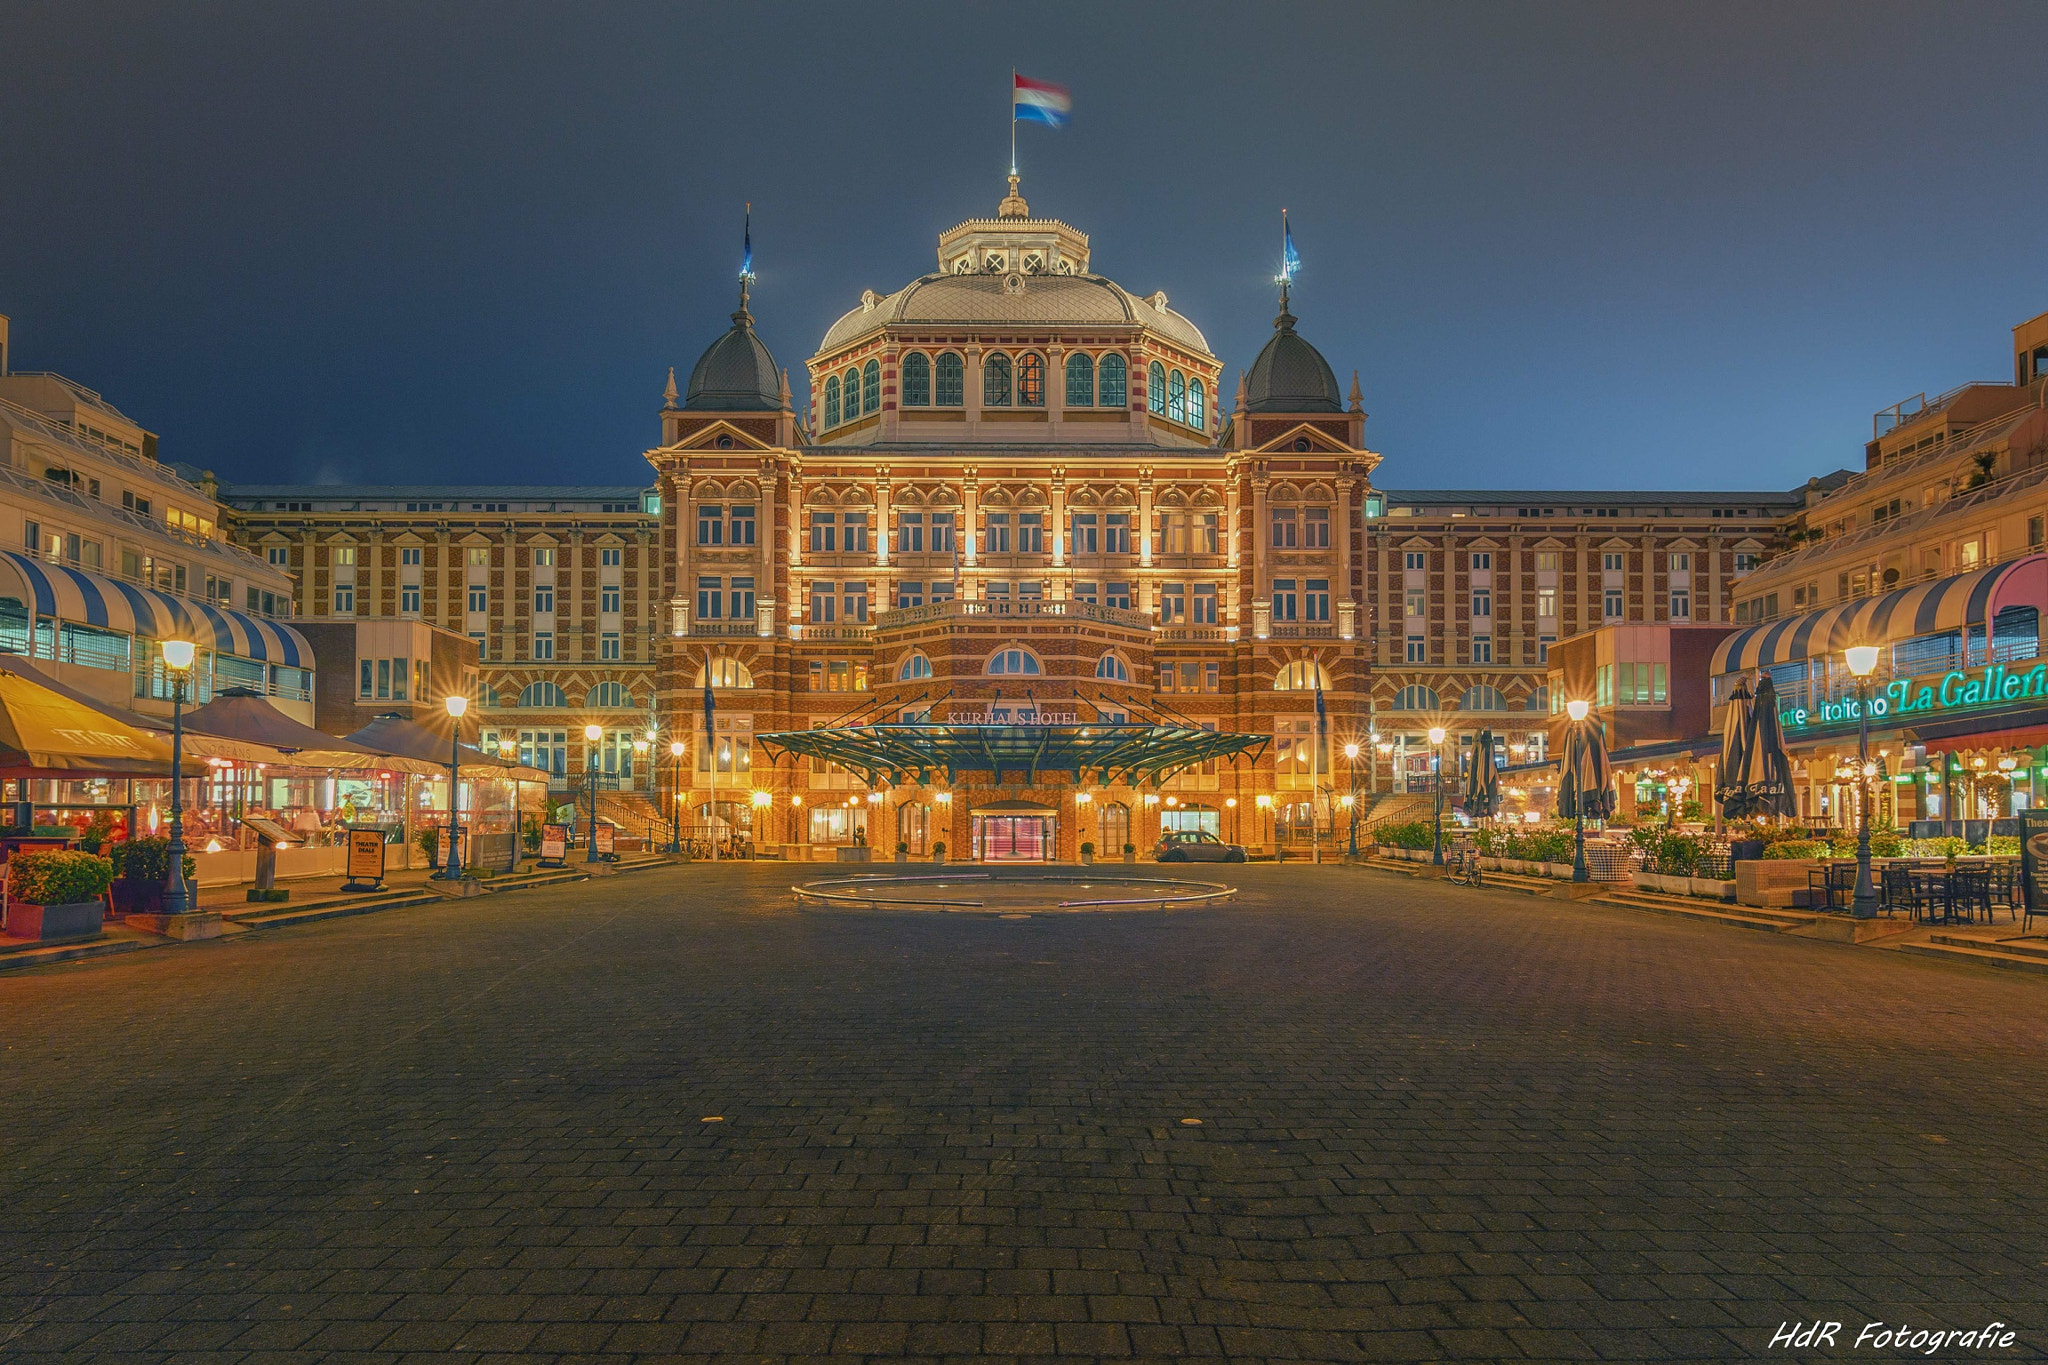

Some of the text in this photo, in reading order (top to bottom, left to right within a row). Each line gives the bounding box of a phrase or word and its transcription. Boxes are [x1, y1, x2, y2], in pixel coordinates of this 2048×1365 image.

[1887, 680, 1933, 712] La
[948, 712, 1082, 726] KURHAUS HOTEL
[1779, 705, 1806, 725] nte
[211, 745, 251, 759] OCEANS
[2025, 818, 2048, 828] Thea
